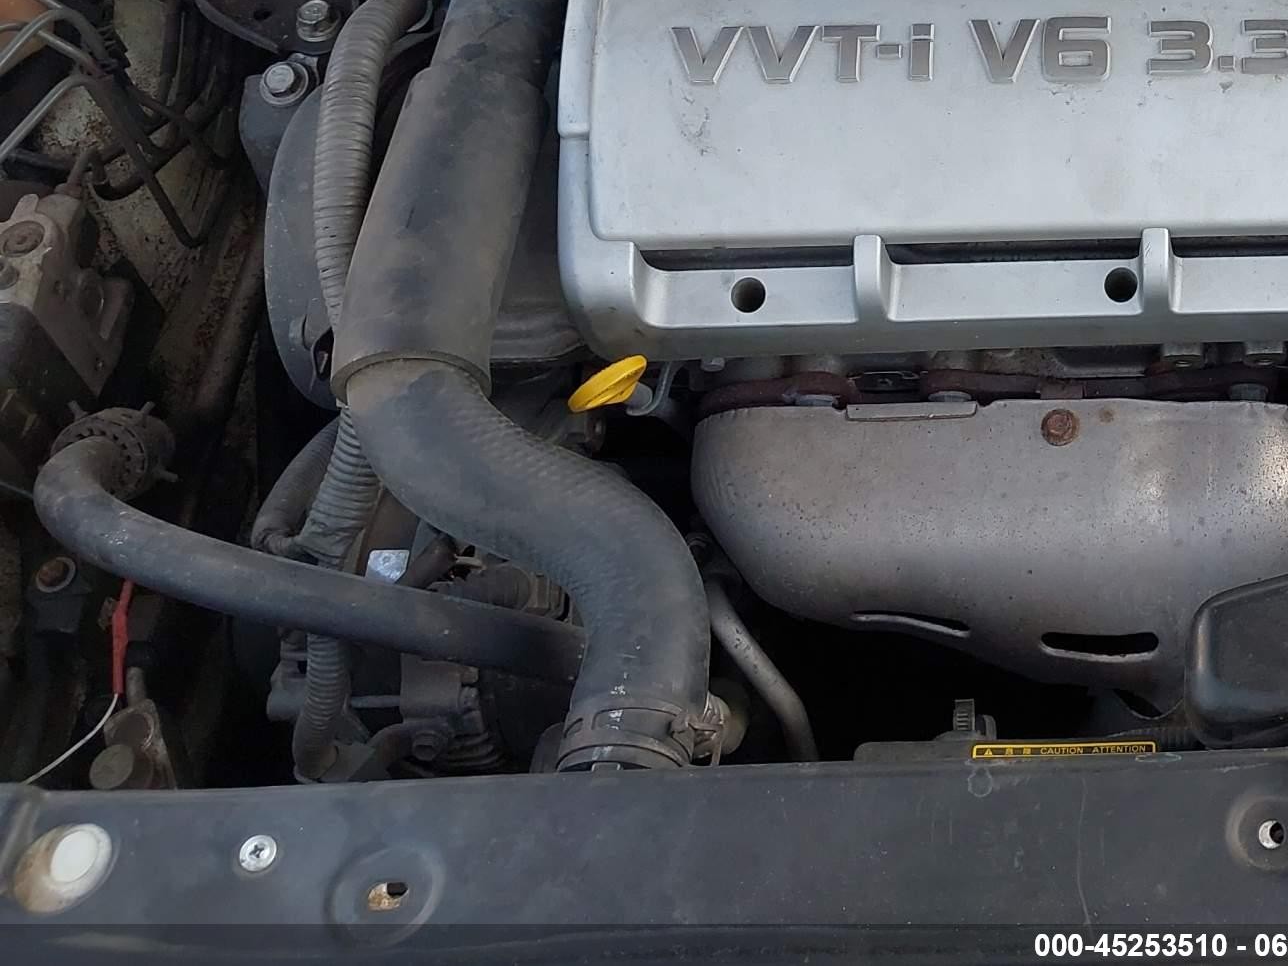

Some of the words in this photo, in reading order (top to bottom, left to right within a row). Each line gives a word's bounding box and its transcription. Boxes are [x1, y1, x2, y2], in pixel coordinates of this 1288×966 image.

[670, 23, 935, 84] VVT-i
[967, 16, 1114, 84] V6
[1040, 747, 1084, 755] CAUTION
[1092, 745, 1146, 754] ATTENTION
